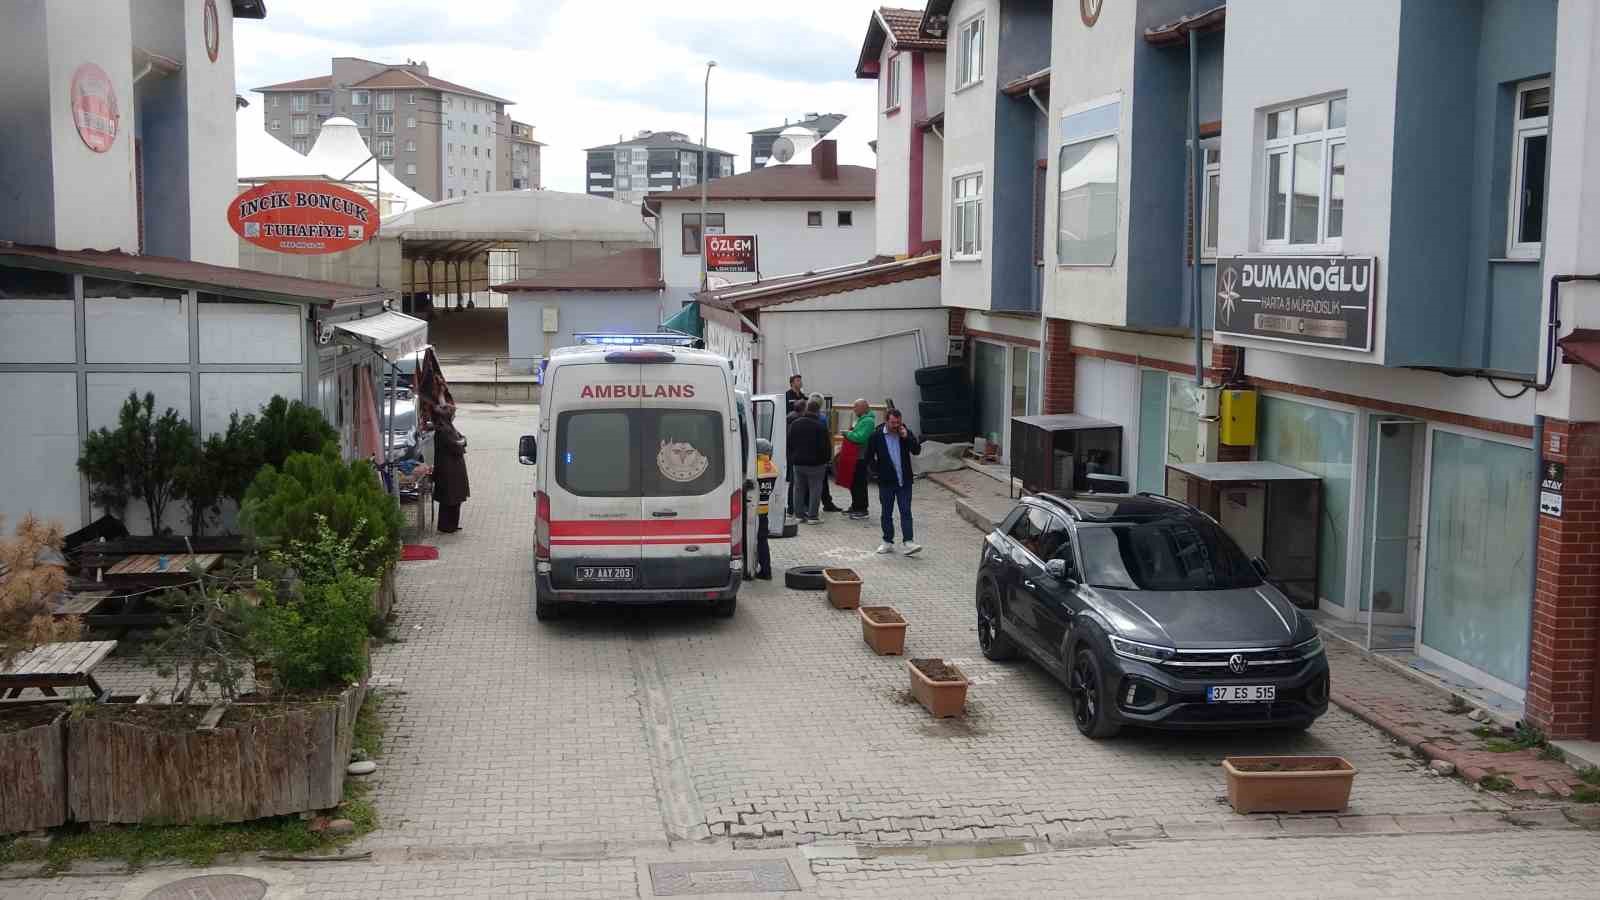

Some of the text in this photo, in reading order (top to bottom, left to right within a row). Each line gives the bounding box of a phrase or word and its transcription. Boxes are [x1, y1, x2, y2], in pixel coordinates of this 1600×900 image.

[295, 192, 369, 223] BONCUK
[263, 221, 345, 238] TUHAFİYE
[710, 237, 751, 251] ÖZLEM
[1241, 260, 1369, 292] DUMANOĞLU
[580, 384, 695, 399] AMBULANS
[1542, 479, 1562, 490] ATAY
[583, 568, 630, 578] 37 AAY 203
[1214, 687, 1274, 699] 37 ES 515
